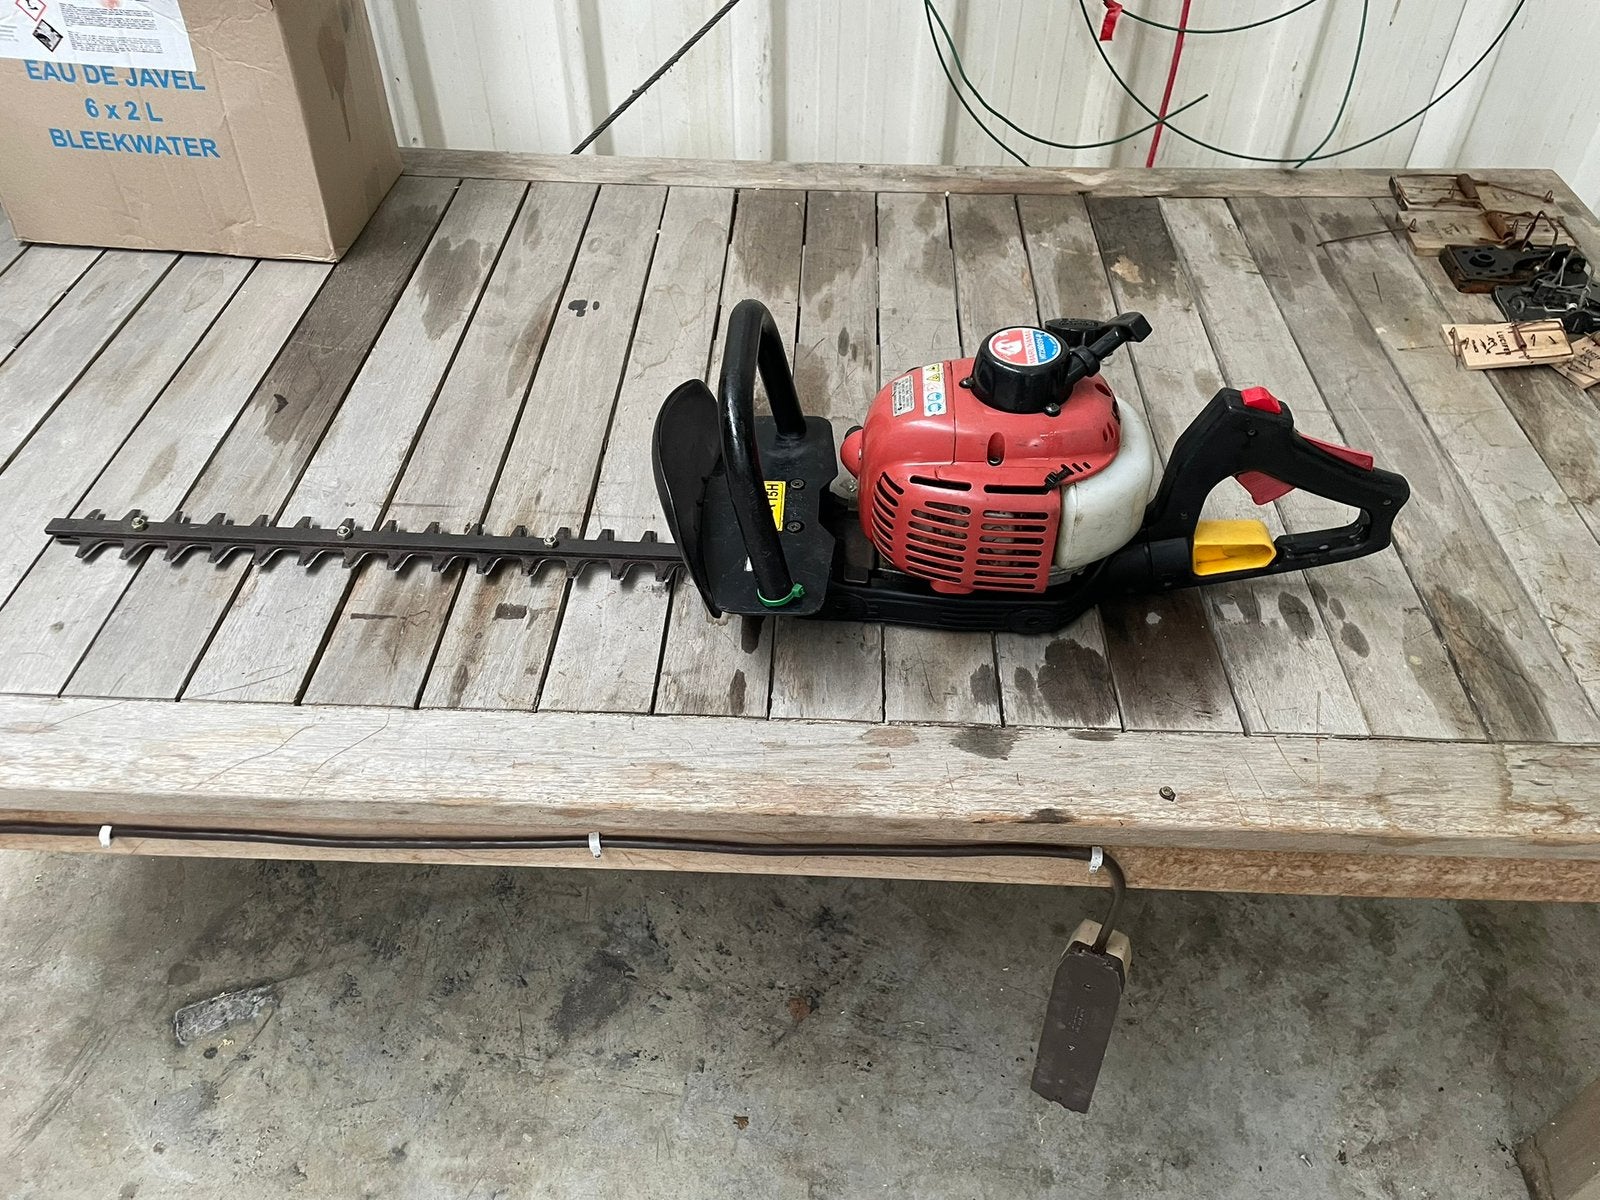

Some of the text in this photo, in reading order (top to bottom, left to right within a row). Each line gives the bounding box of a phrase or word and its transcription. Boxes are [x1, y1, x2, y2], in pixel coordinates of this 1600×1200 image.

[24, 60, 206, 91] EAU DE JAVEL
[84, 97, 164, 122] 6 x 2 L
[49, 128, 221, 158] BLEEKWATER
